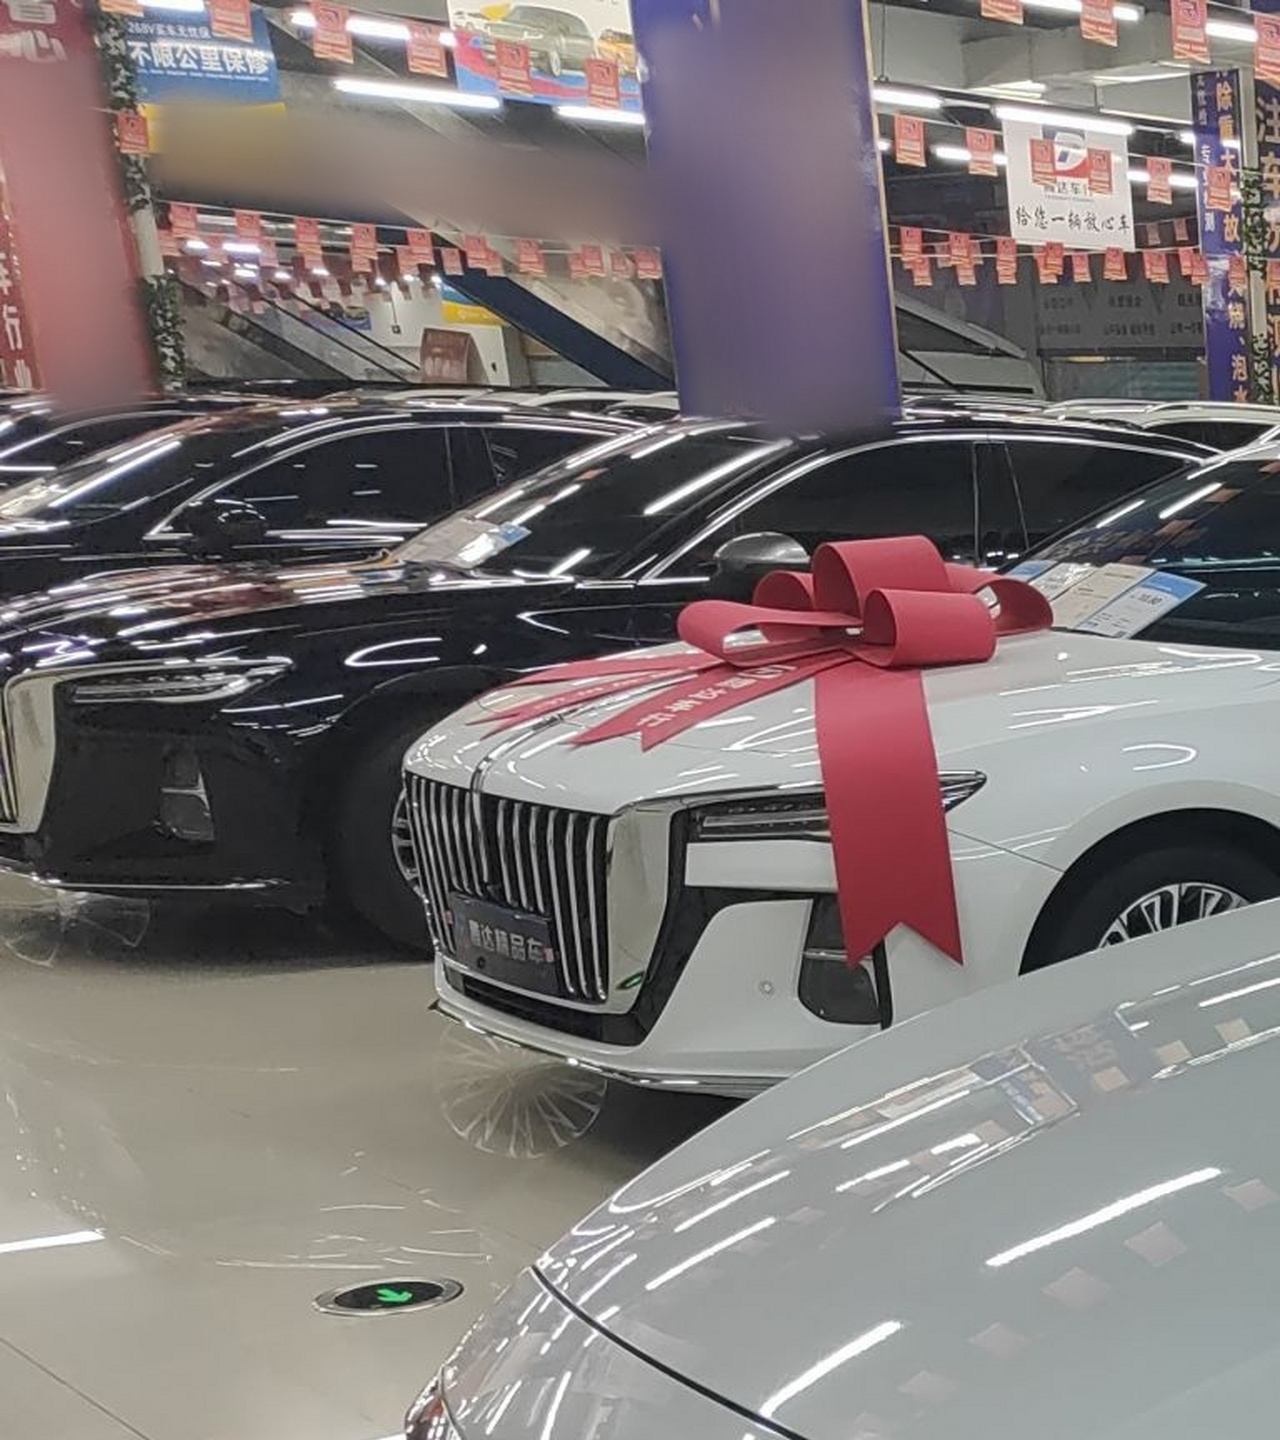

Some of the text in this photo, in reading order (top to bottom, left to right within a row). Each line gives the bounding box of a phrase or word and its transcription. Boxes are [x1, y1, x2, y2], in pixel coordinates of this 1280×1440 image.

[127, 41, 269, 74] 不限公里保修
[1016, 204, 1131, 234] 给您一辆放心车
